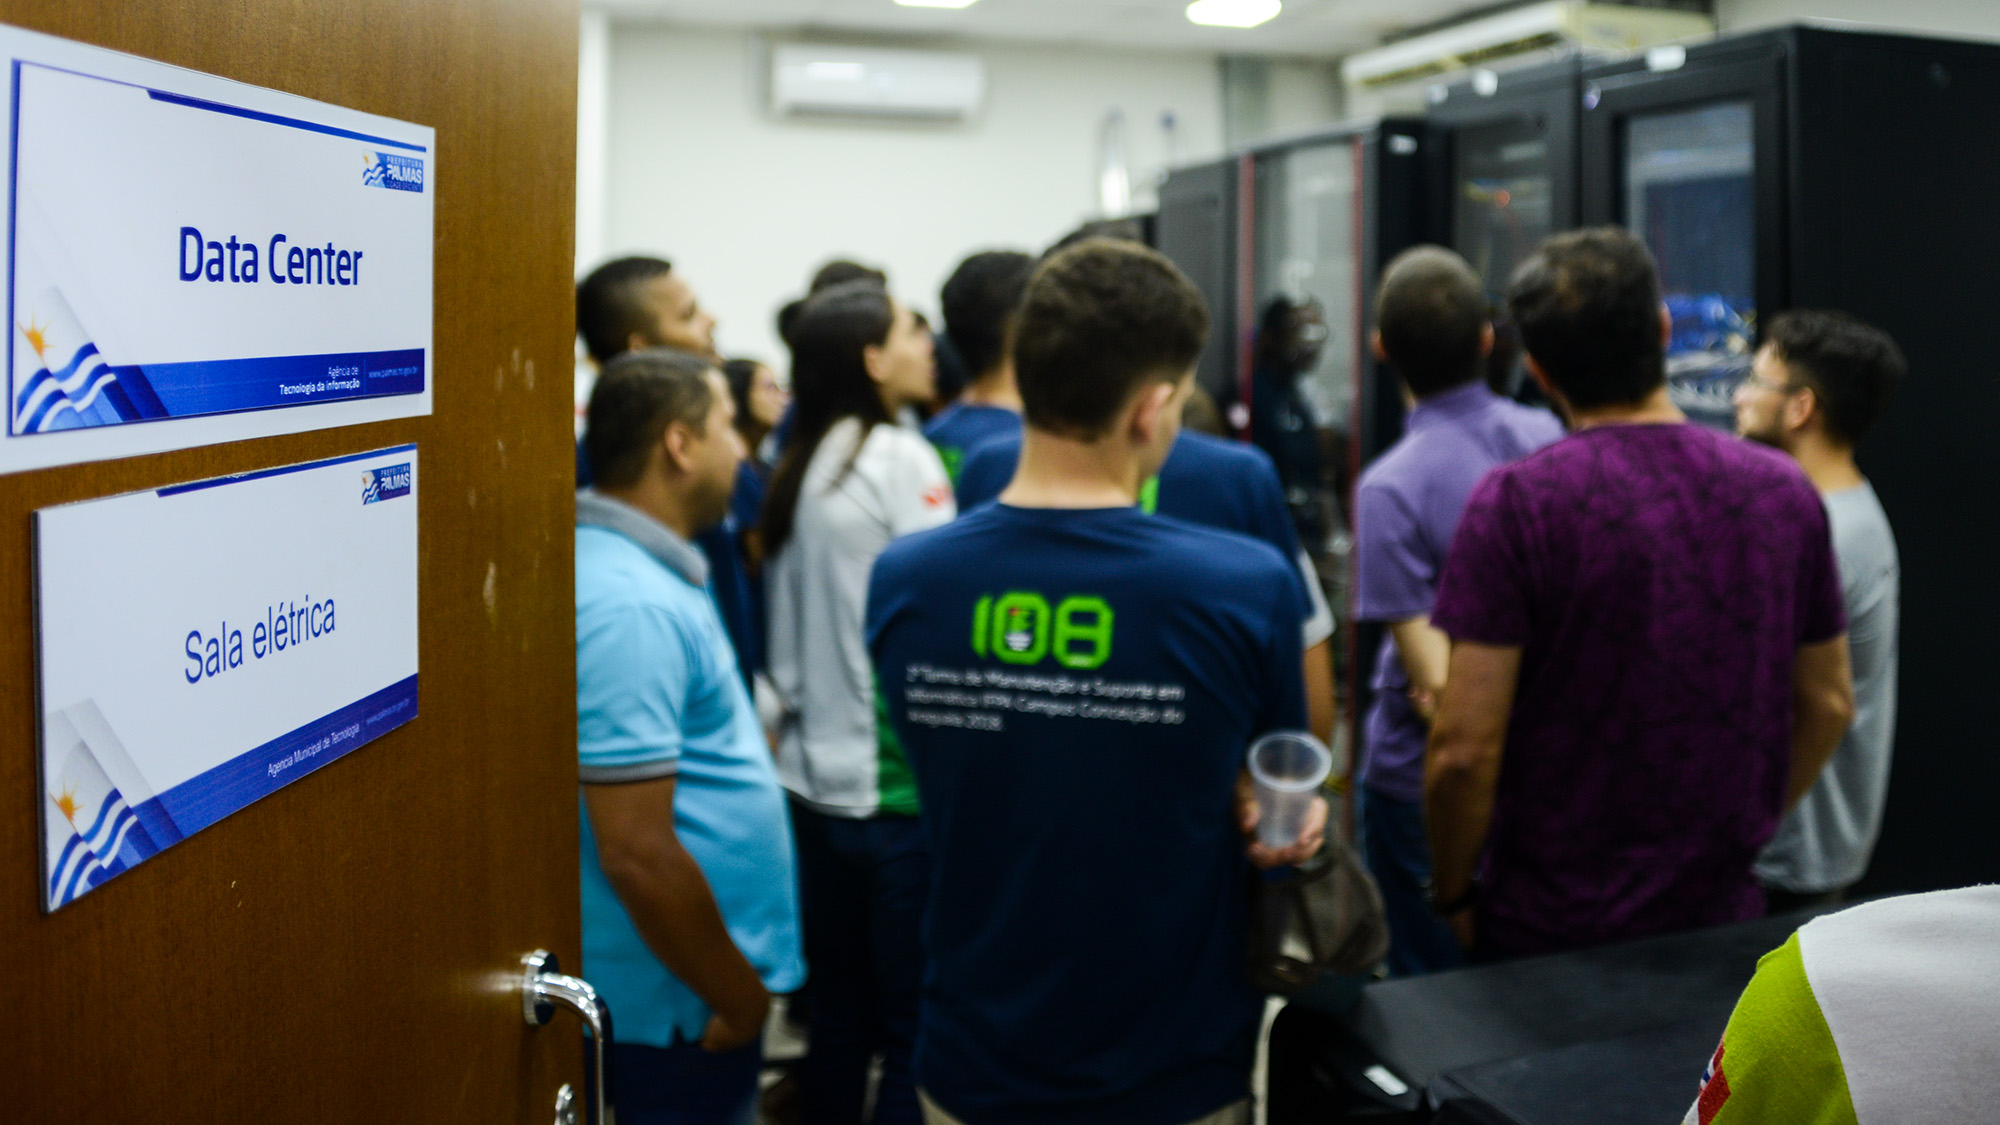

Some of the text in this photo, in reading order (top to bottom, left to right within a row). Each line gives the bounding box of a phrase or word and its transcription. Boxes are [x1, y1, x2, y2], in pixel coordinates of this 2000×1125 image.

[387, 164, 422, 184] PALMAS
[179, 226, 363, 286] Data Center
[328, 365, 359, 379] Agência de
[279, 378, 360, 395] Tecnologia da informação
[381, 472, 410, 491] PALMAS
[185, 594, 335, 684] Sala elétrica
[972, 590, 1115, 670] 108
[293, 738, 322, 757] Municipal
[322, 736, 331, 750] de
[331, 723, 360, 745] Tecnologia
